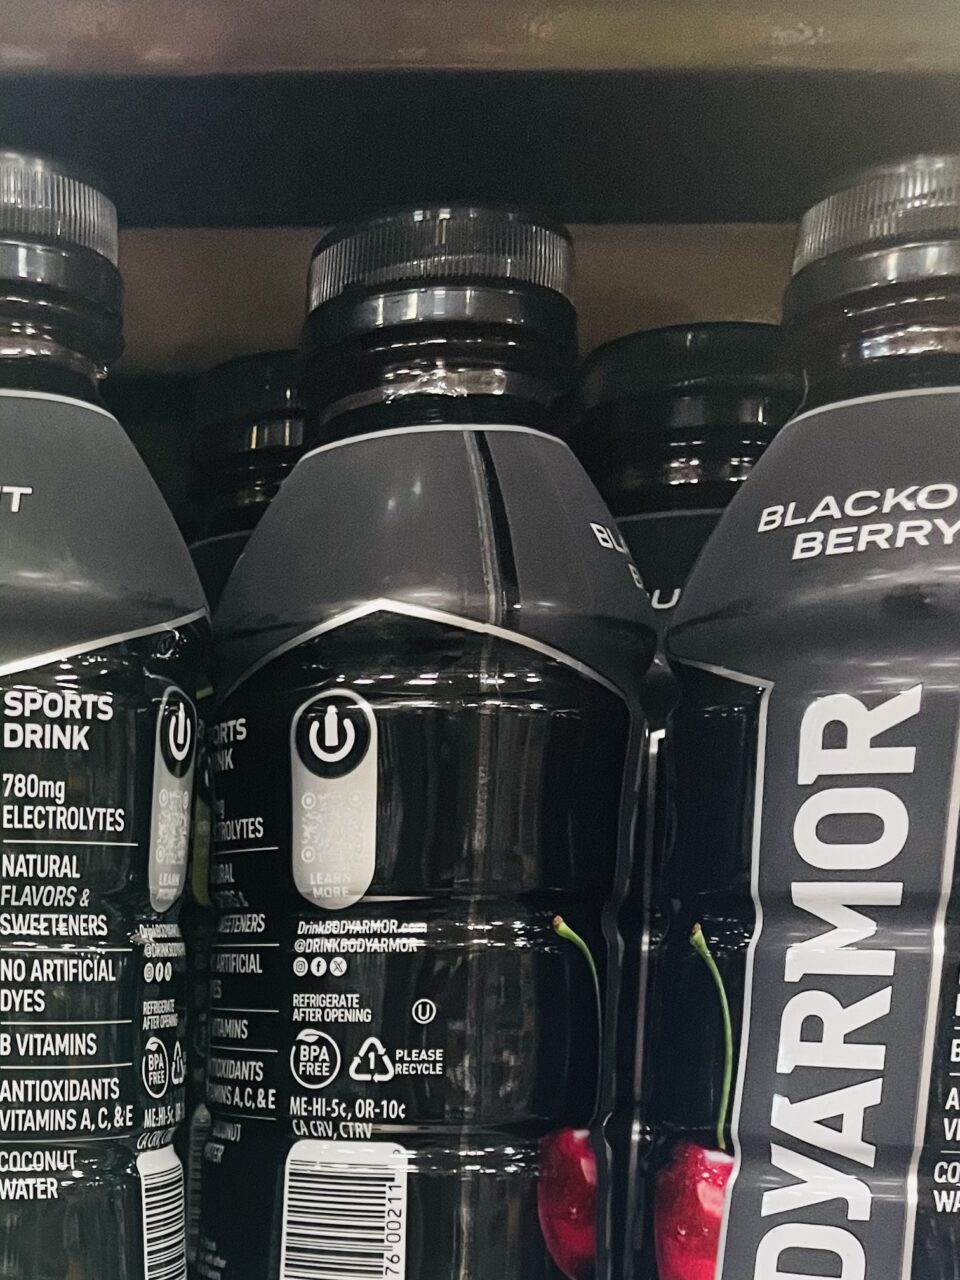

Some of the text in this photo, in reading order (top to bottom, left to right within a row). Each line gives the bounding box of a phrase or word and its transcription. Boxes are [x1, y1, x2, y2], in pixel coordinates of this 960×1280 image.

[758, 483, 958, 532] BLACKO
[792, 519, 960, 560] BERRY
[4, 691, 113, 721] SPORTS
[3, 723, 90, 750] DRINK
[2, 774, 65, 805] 780mg
[3, 805, 125, 832] ELECTROLYTES
[2, 854, 80, 879] NATURAL
[310, 872, 351, 885] LEARN
[1, 885, 89, 907] FLAVORS &
[313, 886, 349, 898] MORE
[0, 913, 107, 936] SWEETENERS
[295, 938, 418, 952] @DRINKBODYARMOR
[0, 959, 116, 982] NO ARTIFICIAL
[0, 990, 46, 1012] DYES
[293, 994, 359, 1008] REFRIGERATE
[293, 1009, 372, 1022] AFTER OPENING
[0, 1033, 97, 1056] B VITAMINS
[300, 1046, 329, 1062] BPA
[396, 1050, 443, 1061] PLEASE
[148, 1054, 163, 1069] BPA
[299, 1063, 330, 1076] FREE
[395, 1064, 443, 1075] RECYCLE
[149, 1071, 165, 1085] FREE
[0, 1078, 119, 1102] ANTIOXIDANTS
[0, 1109, 76, 1132] VITAMINS
[292, 1120, 372, 1140] CA CRV, CTRV
